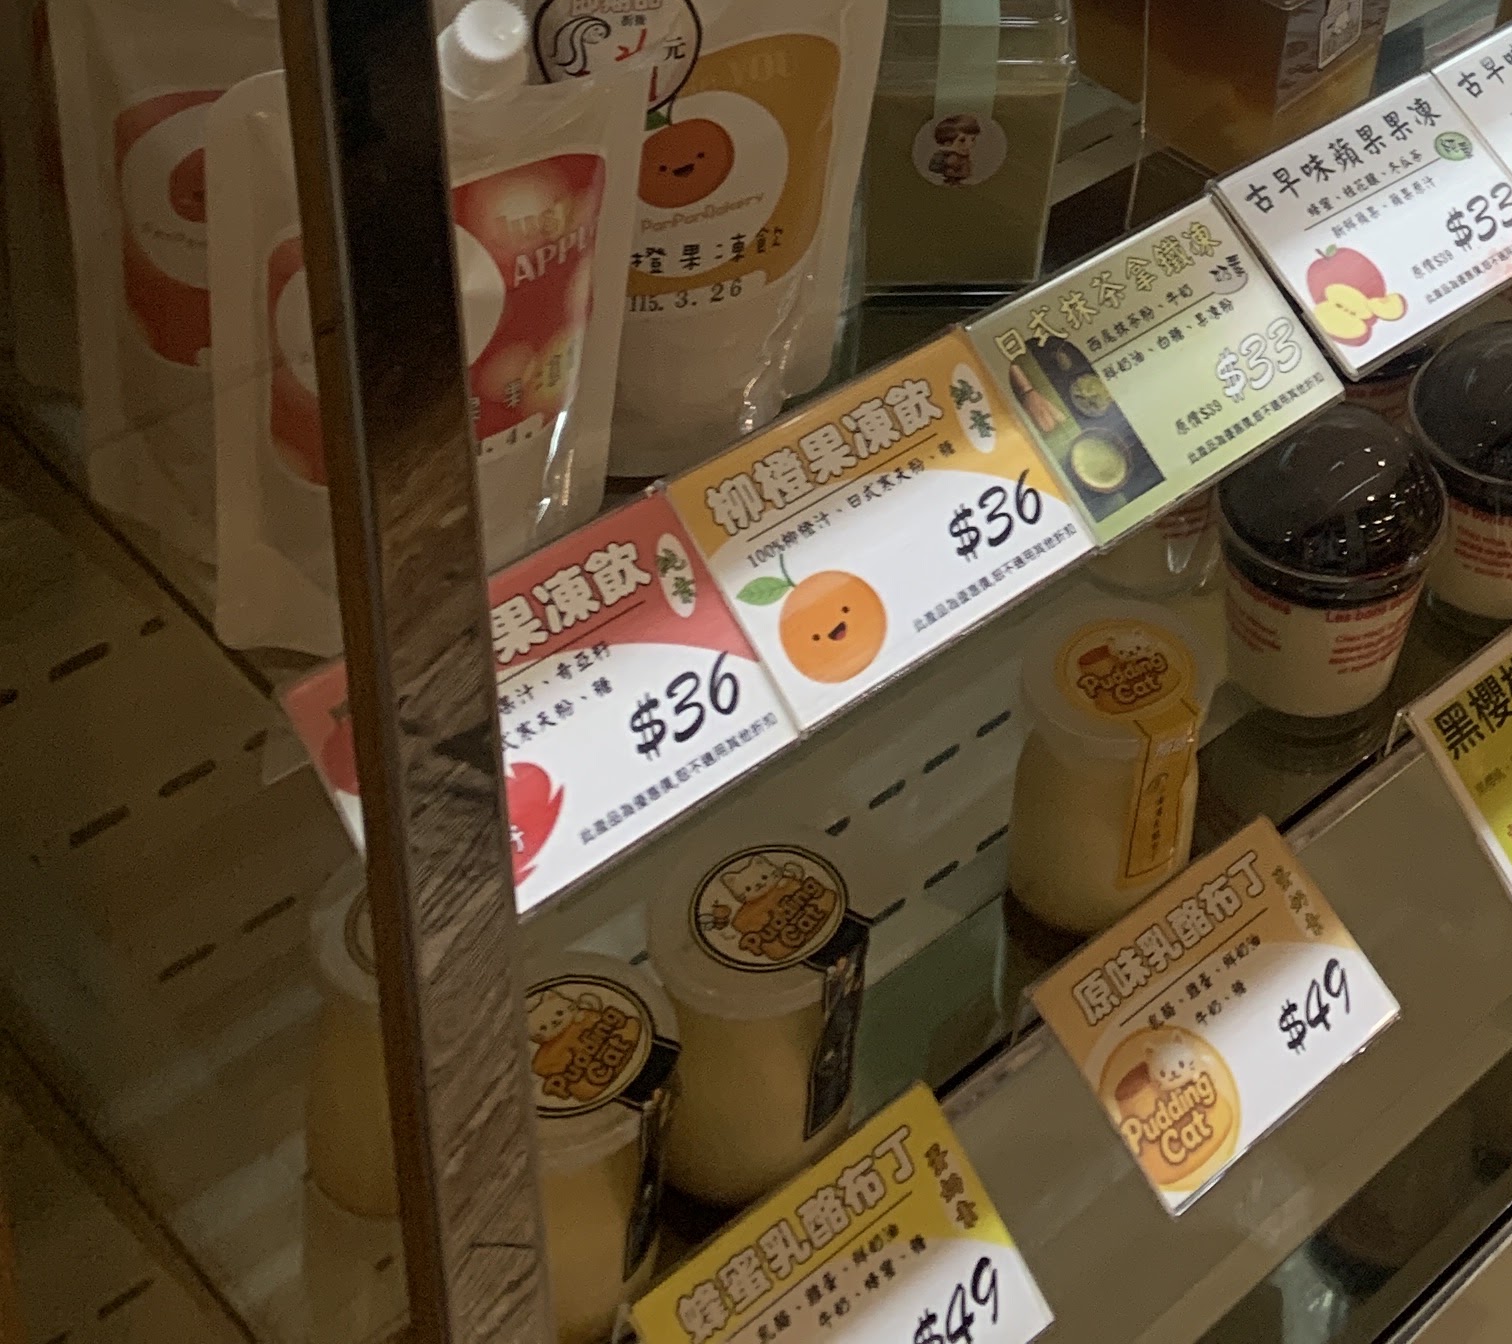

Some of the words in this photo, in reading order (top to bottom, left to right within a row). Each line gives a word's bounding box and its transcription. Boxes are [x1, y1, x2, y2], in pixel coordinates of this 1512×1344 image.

[661, 35, 688, 62] 元
[1235, 92, 1447, 221] 古早味蘋果果凍
[673, 288, 698, 309] 3.
[709, 277, 744, 304] 26
[987, 214, 1227, 369] 日式抹茶拿鐵凍
[1204, 312, 1315, 407] $33
[943, 372, 1006, 443] 純素
[697, 371, 951, 542] 柳橙果凍飲
[933, 462, 1061, 569] $36
[490, 531, 655, 668] 果凍飲
[623, 647, 753, 773] $36
[1076, 652, 1169, 699] Pudding
[1112, 674, 1163, 705] Cat
[738, 875, 828, 958] Pudding
[779, 903, 826, 950] Cat
[1067, 846, 1277, 1030] 原味乳酪布丁
[1278, 958, 1352, 1054] $49
[541, 1004, 629, 1101] Pudding
[585, 1034, 631, 1086] Cat
[1119, 1069, 1218, 1156] Pudding
[1160, 1111, 1214, 1166] Cat
[675, 1124, 915, 1344] 蜂蜜乳酪布丁
[913, 1256, 999, 1344] $49
